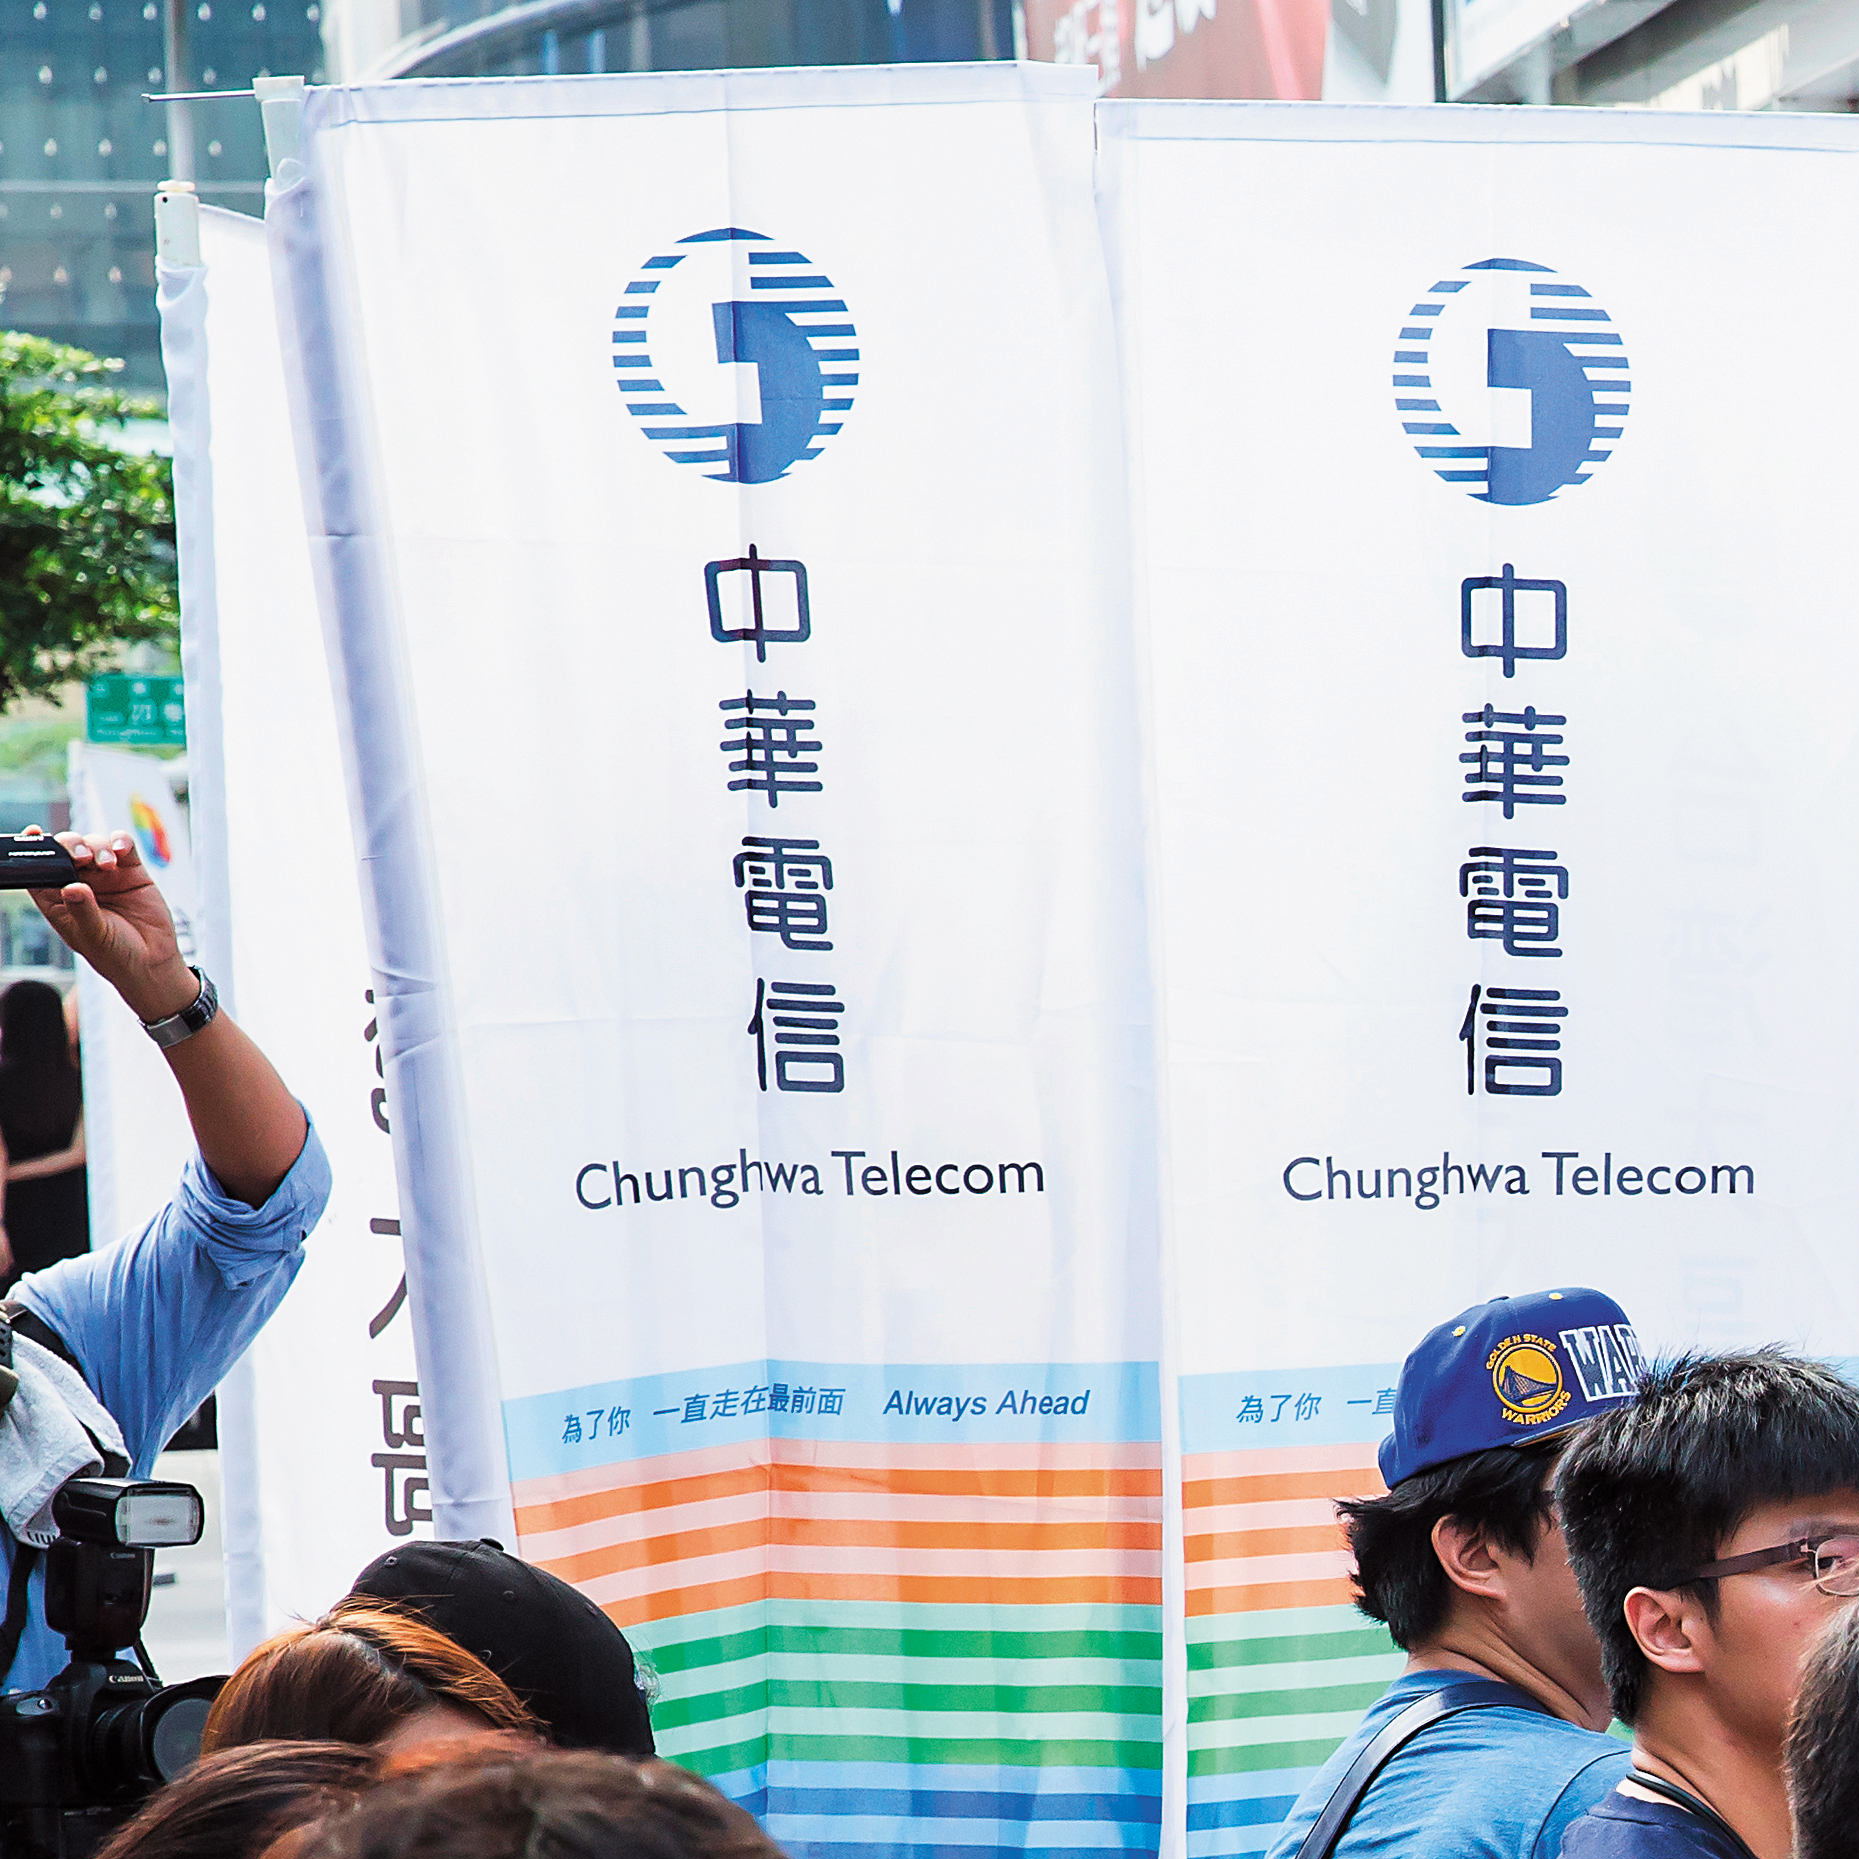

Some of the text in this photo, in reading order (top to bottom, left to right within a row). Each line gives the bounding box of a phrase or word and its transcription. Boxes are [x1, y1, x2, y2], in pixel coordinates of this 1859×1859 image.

[702, 542, 846, 1095] 中華電信
[1457, 562, 1571, 1098] 中華電信
[575, 1147, 1045, 1211] Chunghwa Telecom
[1282, 1150, 1755, 1211] Chunghwa Telecom
[1486, 1333, 1557, 1370] GOLDEN STATE
[561, 1383, 1091, 1445] 為了你 一直走在最前面 Always Ahead
[1235, 1392, 1323, 1424] 為了你
[1501, 1390, 1572, 1426] WARRIORS
